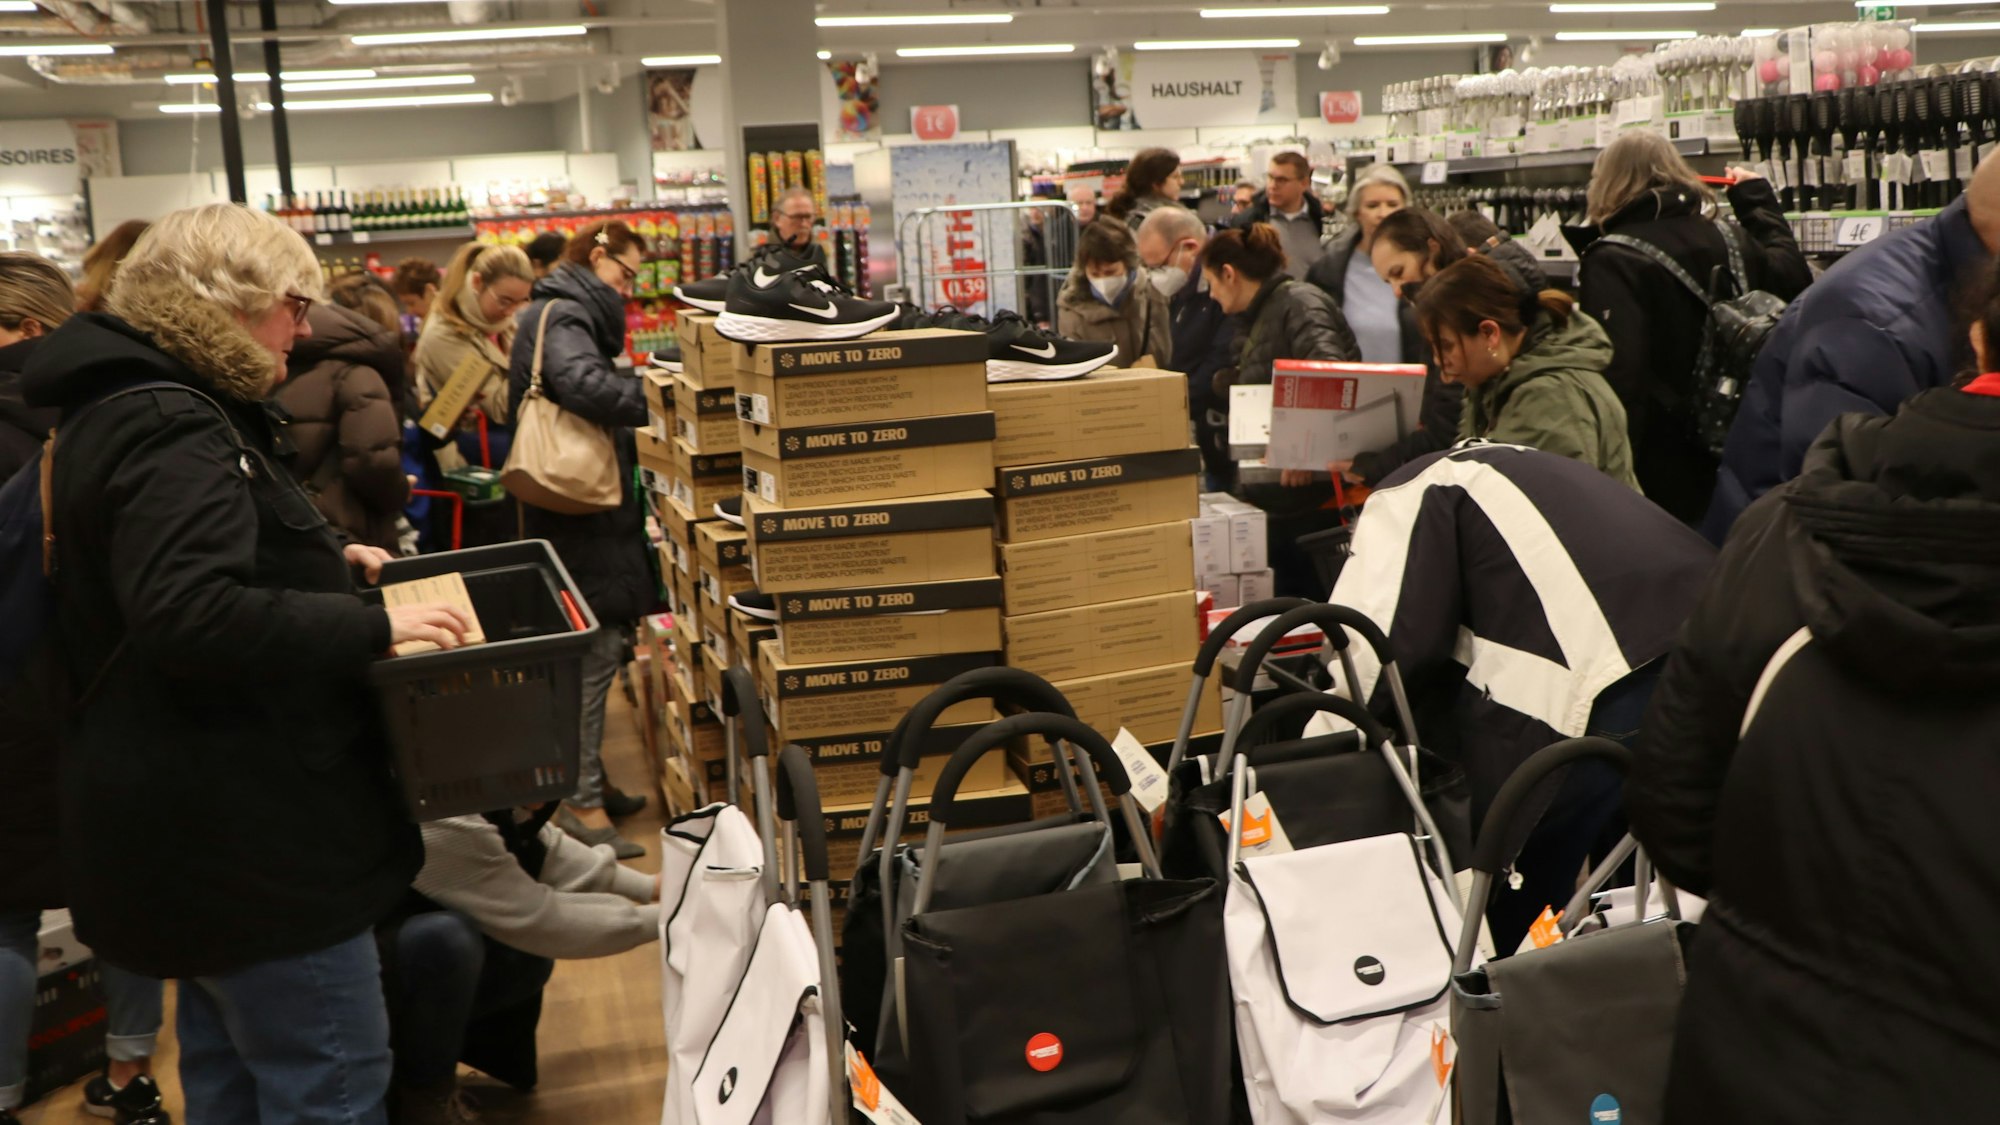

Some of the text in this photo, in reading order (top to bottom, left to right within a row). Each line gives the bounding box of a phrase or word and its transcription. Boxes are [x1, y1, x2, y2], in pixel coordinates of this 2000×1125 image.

[1151, 82, 1242, 98] HAUSHALT
[923, 116, 946, 132] 1€
[0, 148, 76, 165] SOIRES
[1849, 223, 1871, 241] 4€
[948, 278, 986, 298] 0.39
[801, 347, 902, 366] MOVE TO ZERO
[806, 428, 907, 448] MOVE TO ZERO
[1030, 465, 1122, 486] MOVE TO ZERO
[783, 512, 890, 531] MOVE TO ZERO
[809, 593, 914, 611] MOVE TO ZERO
[805, 667, 909, 687] MOVE TO ZERO
[819, 741, 882, 757] MOVE TO
[909, 812, 929, 824] ZE
